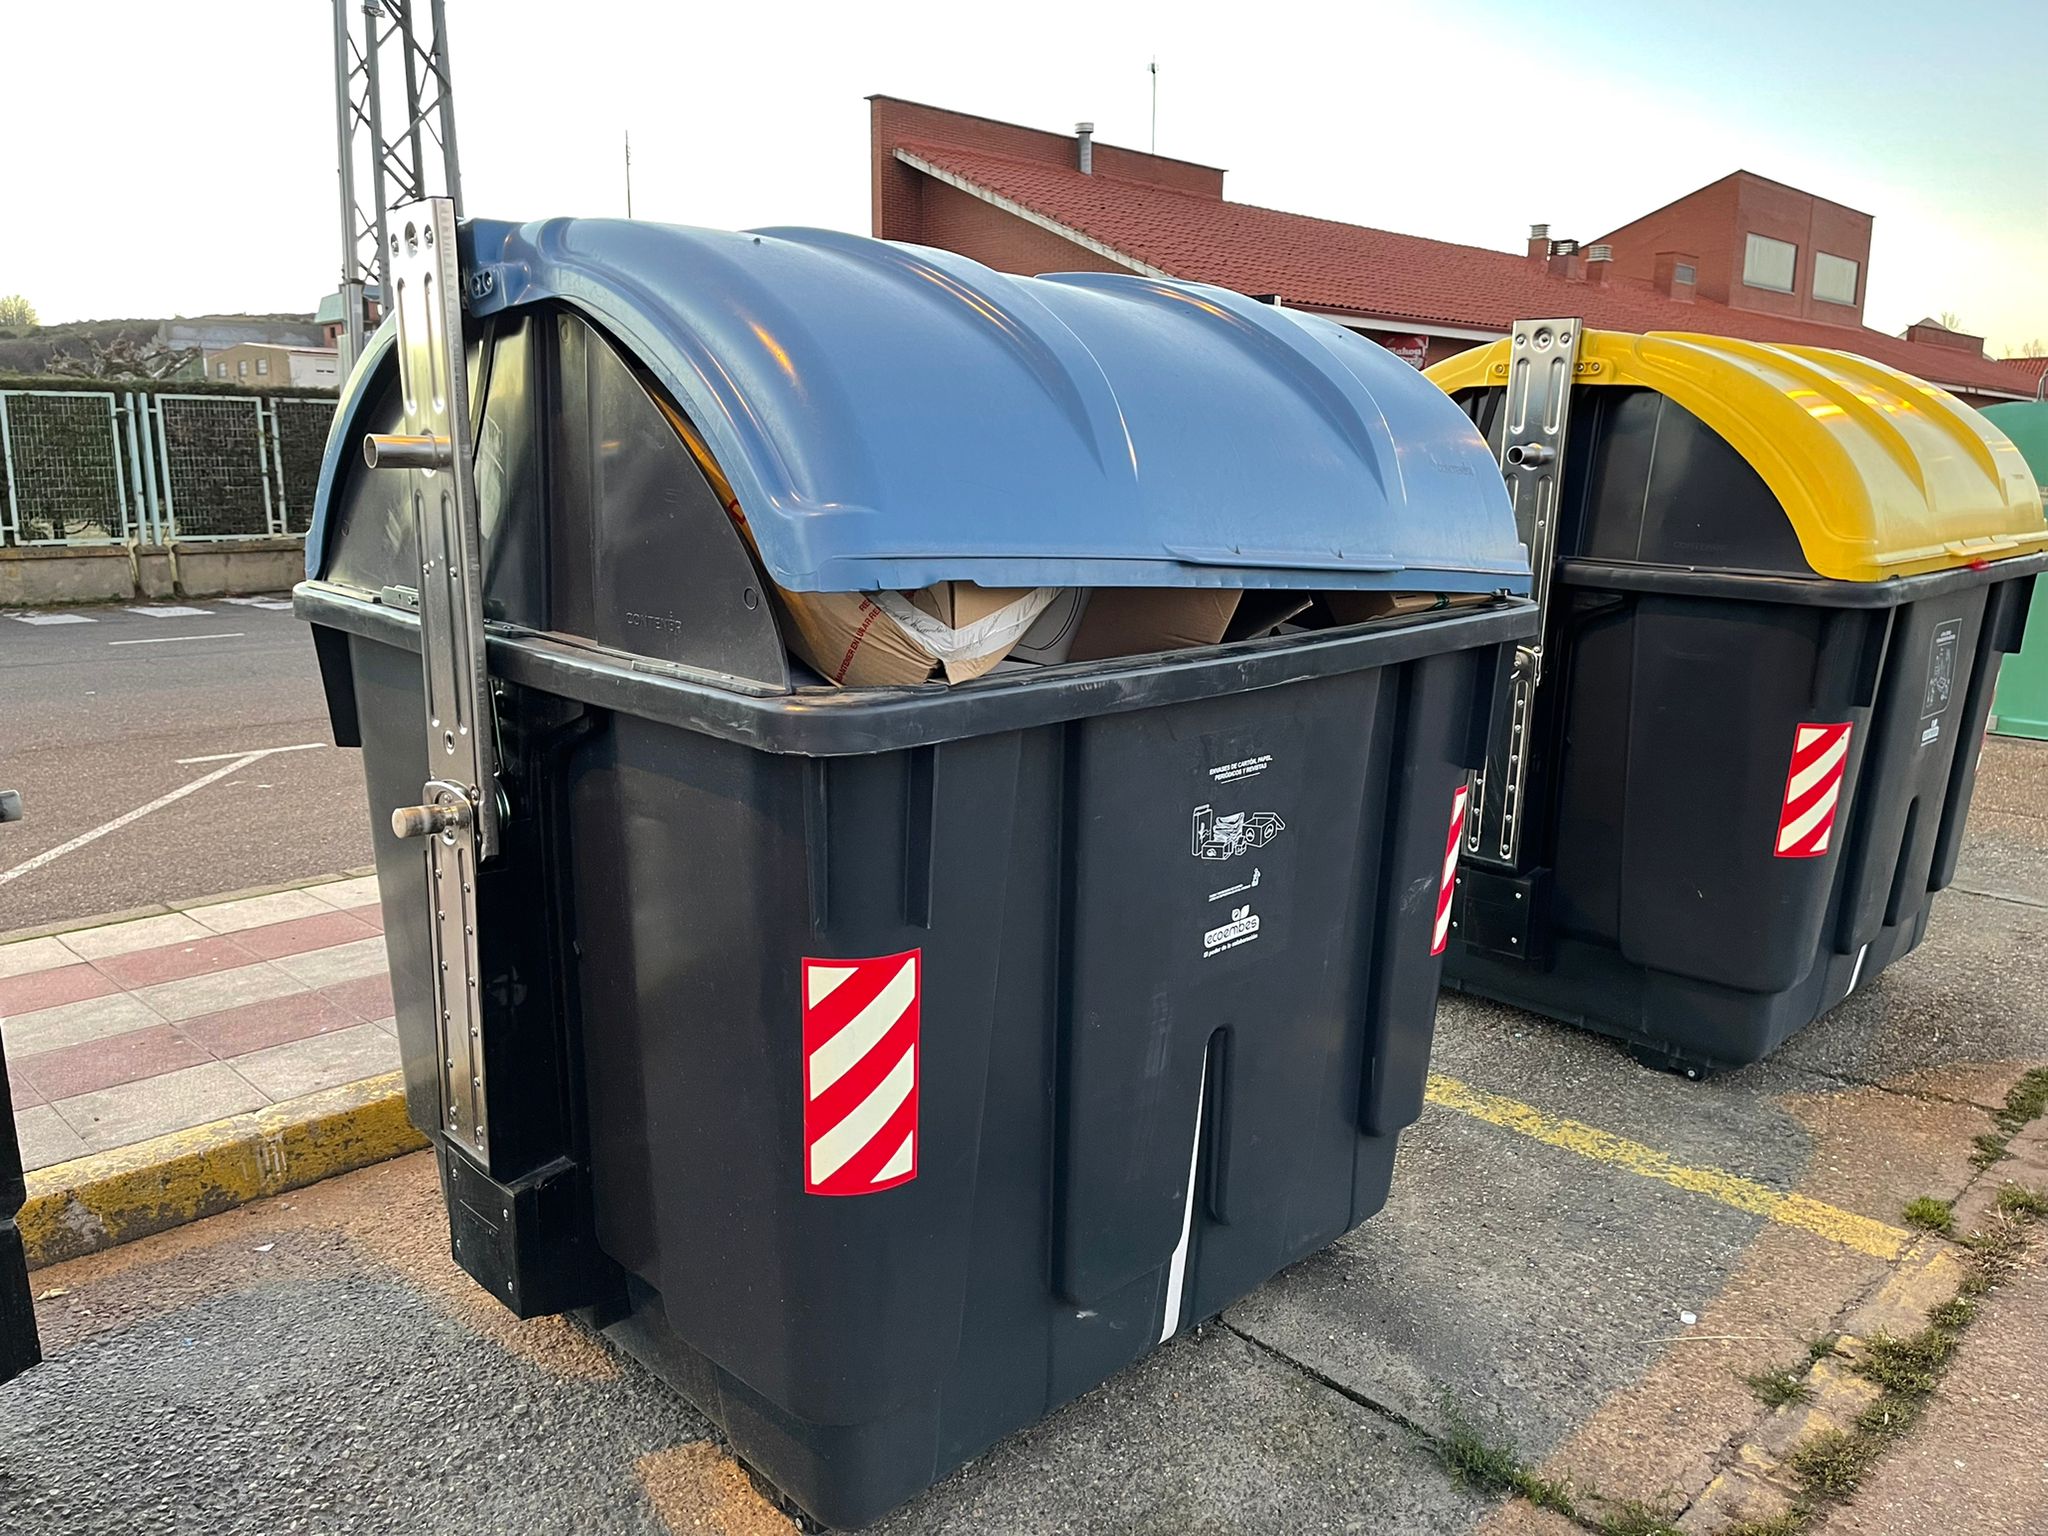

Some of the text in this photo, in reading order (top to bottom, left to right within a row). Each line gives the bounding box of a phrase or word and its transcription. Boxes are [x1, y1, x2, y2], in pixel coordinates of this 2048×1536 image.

[859, 598, 872, 612] RE
[835, 649, 856, 684] MANTENER
[850, 639, 861, 651] EN
[1231, 762, 1238, 770] DE
[1206, 918, 1257, 945] ecoembes
